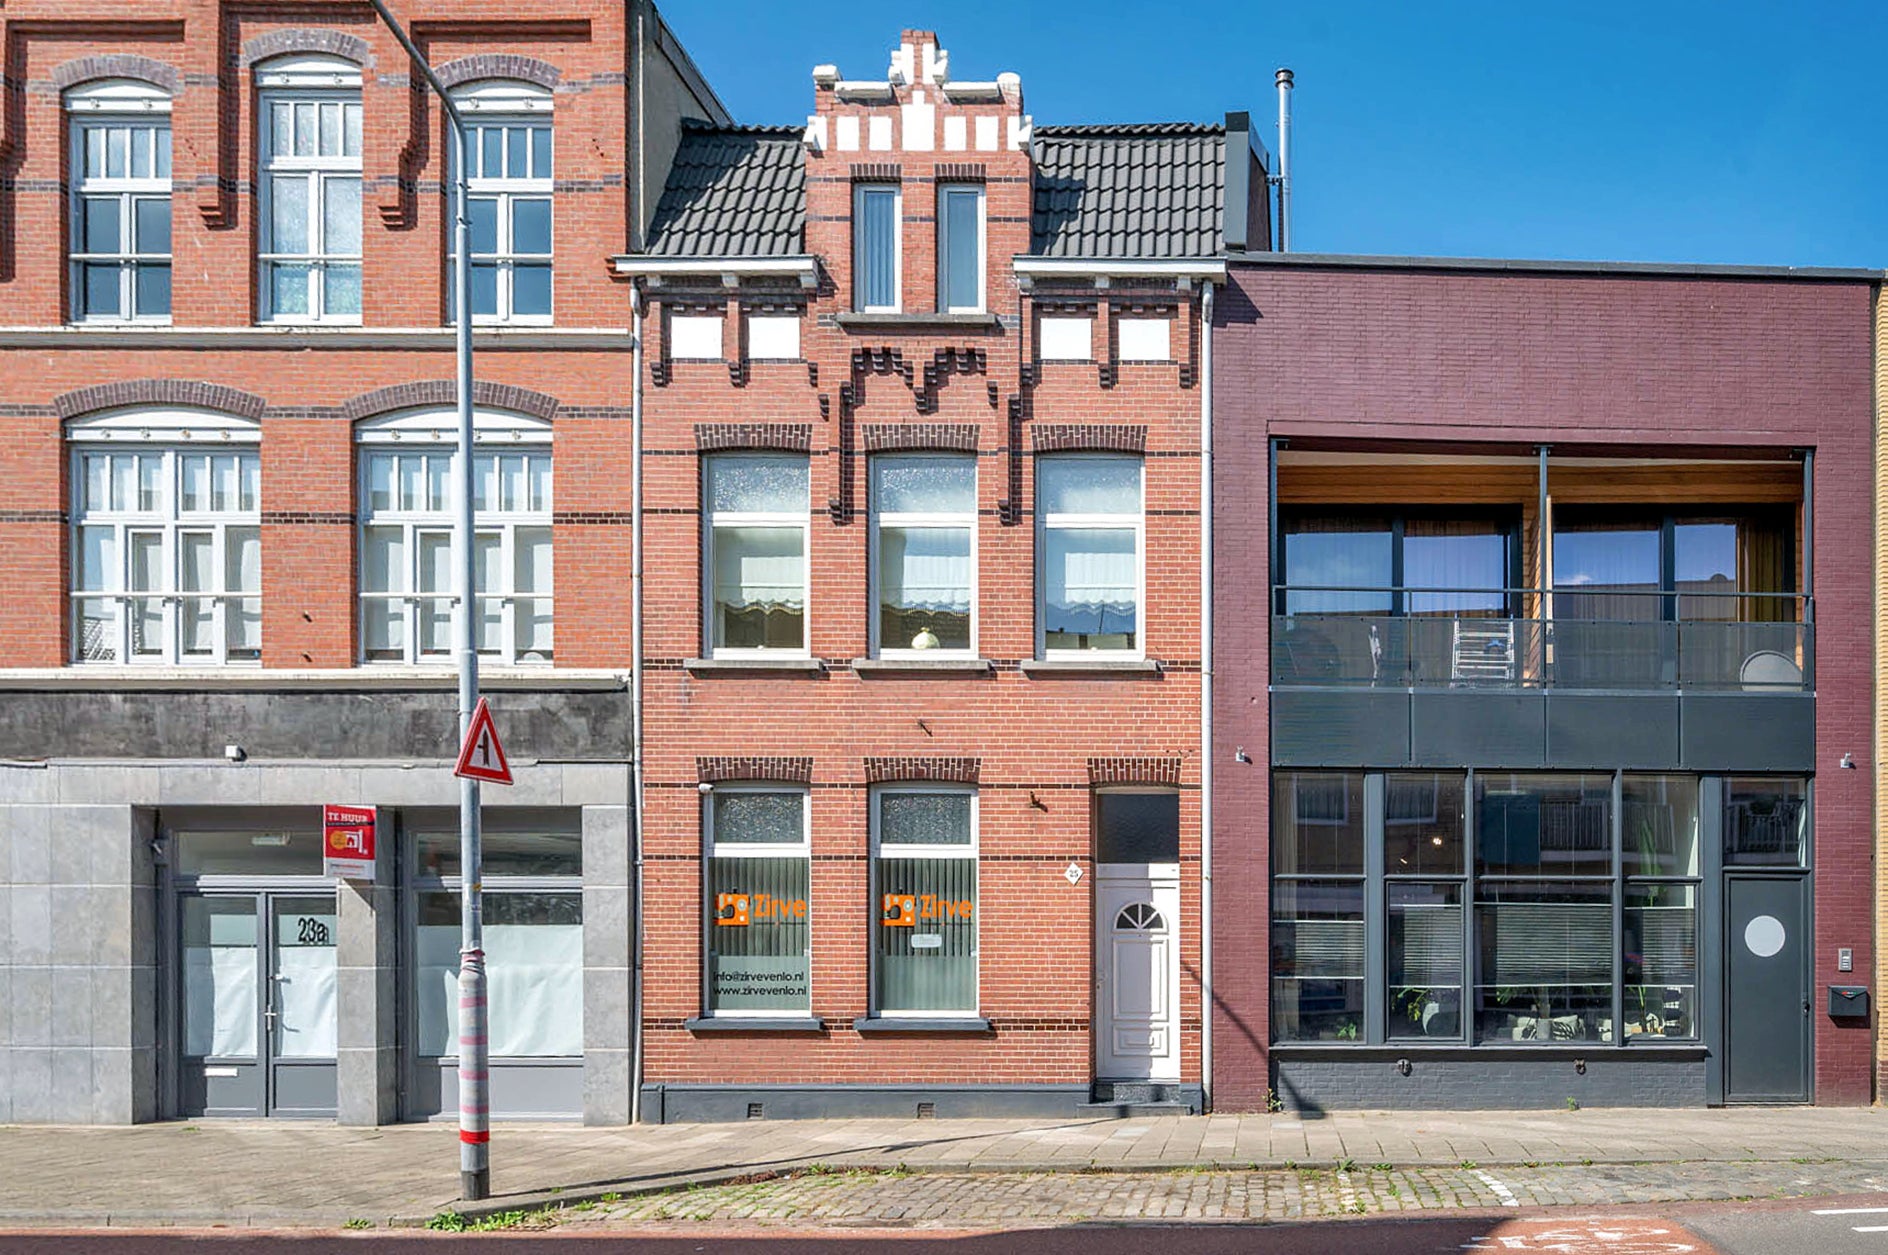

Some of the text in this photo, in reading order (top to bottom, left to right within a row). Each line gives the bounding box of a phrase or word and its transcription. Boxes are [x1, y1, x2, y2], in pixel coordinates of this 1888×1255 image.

[327, 812, 368, 822] TE HUUR
[753, 893, 807, 918] Zirve
[920, 893, 973, 919] Zirve
[298, 917, 326, 942] 23a
[713, 971, 804, 982] info@zirvevenlo.nl
[713, 986, 807, 996] www.zirvevenlo.nl
